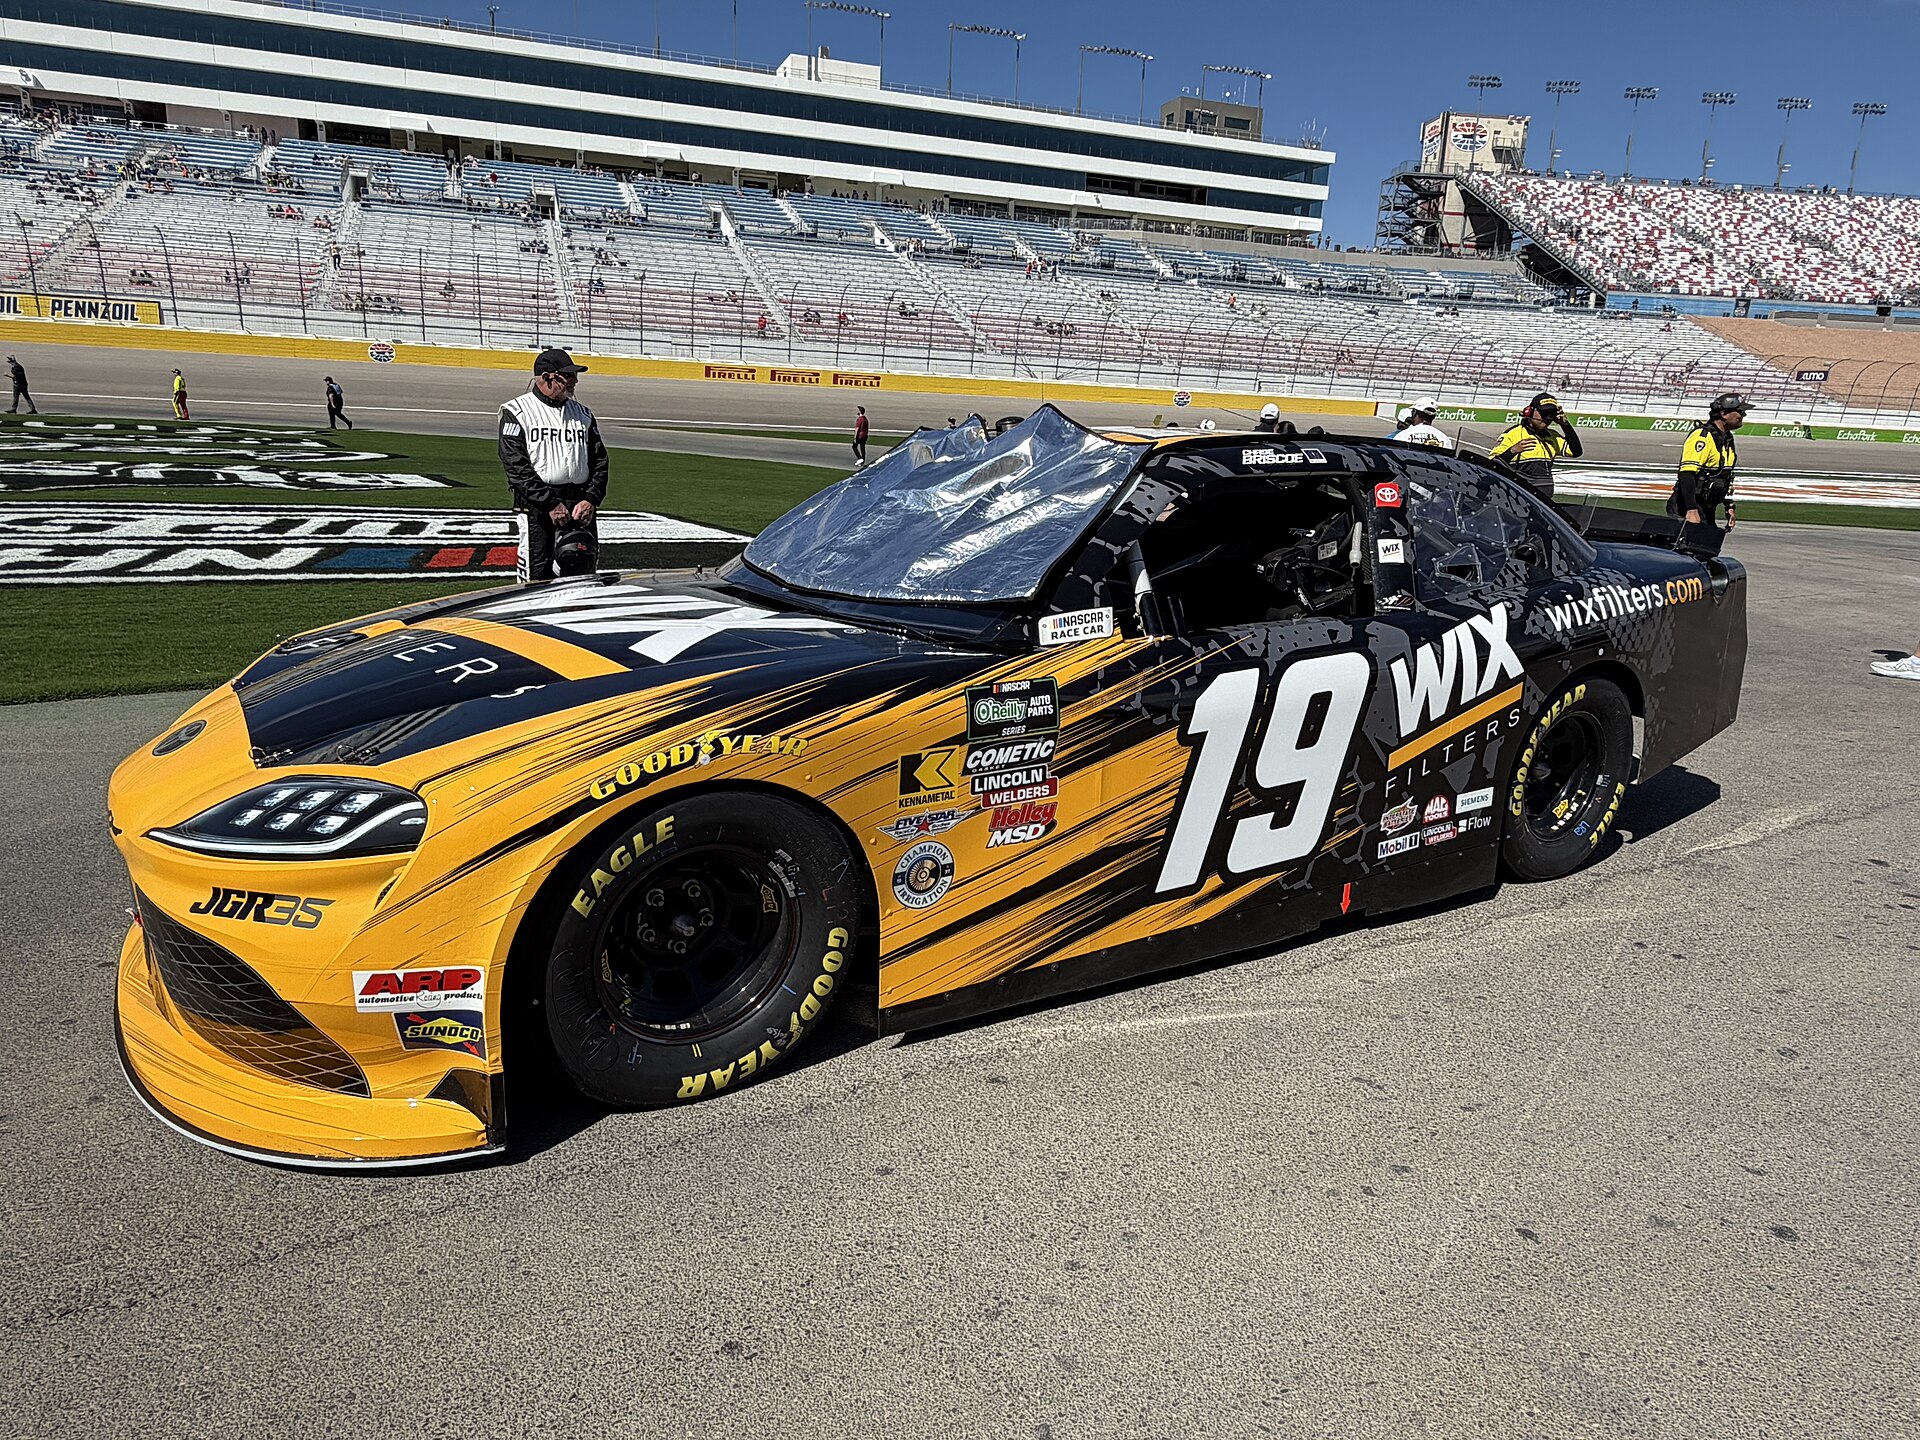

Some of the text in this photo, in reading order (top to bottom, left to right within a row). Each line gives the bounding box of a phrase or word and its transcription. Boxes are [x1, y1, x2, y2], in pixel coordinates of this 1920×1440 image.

[51, 300, 139, 321] PENNZOIL
[705, 365, 756, 380] PIRELLI
[770, 369, 820, 384] PIRELLI
[832, 373, 881, 387] PIRELLI
[1576, 416, 1618, 429] EchoPark
[531, 427, 587, 443] OFFICIA
[1837, 430, 1877, 441] EchoPark
[1242, 453, 1303, 464] BRISCOE
[1382, 543, 1400, 554] WIX
[1545, 577, 1703, 632] wixfilters.com
[1064, 611, 1103, 628] NASCAR
[1051, 625, 1104, 640] RACE CAR
[1390, 602, 1525, 738] WIX
[1001, 680, 1031, 693] NASCAR
[975, 694, 1051, 723] O'Reilly AUTO
[1027, 705, 1054, 718] PARTS
[1001, 725, 1026, 736] SERIES
[966, 740, 1055, 769] COMETIC
[1385, 708, 1521, 798] FILTERS
[590, 733, 809, 800] GOODYEAR
[1155, 651, 1371, 893] 19
[974, 768, 1043, 793] LINCOLN
[898, 790, 955, 808] KENNAMETAL
[989, 785, 1050, 804] WELDERS
[1460, 794, 1489, 807] SIEMENS
[895, 815, 923, 830] FIVE
[991, 802, 1058, 830] Holley
[1424, 811, 1448, 822] TOOLS
[1468, 816, 1491, 831] Flow
[987, 823, 1047, 848] MSD
[1423, 823, 1451, 837] LINCOLN
[1380, 838, 1407, 857] Mobil
[900, 844, 949, 869] CHAMPION
[571, 815, 675, 919] EAGLE
[897, 878, 949, 906] IRRIGATION
[189, 886, 336, 929] JGR35
[359, 968, 482, 995] ARP
[358, 994, 415, 1004] automotive
[676, 926, 849, 1098] GOODYEAR
[408, 1026, 480, 1041] SUNOCO
